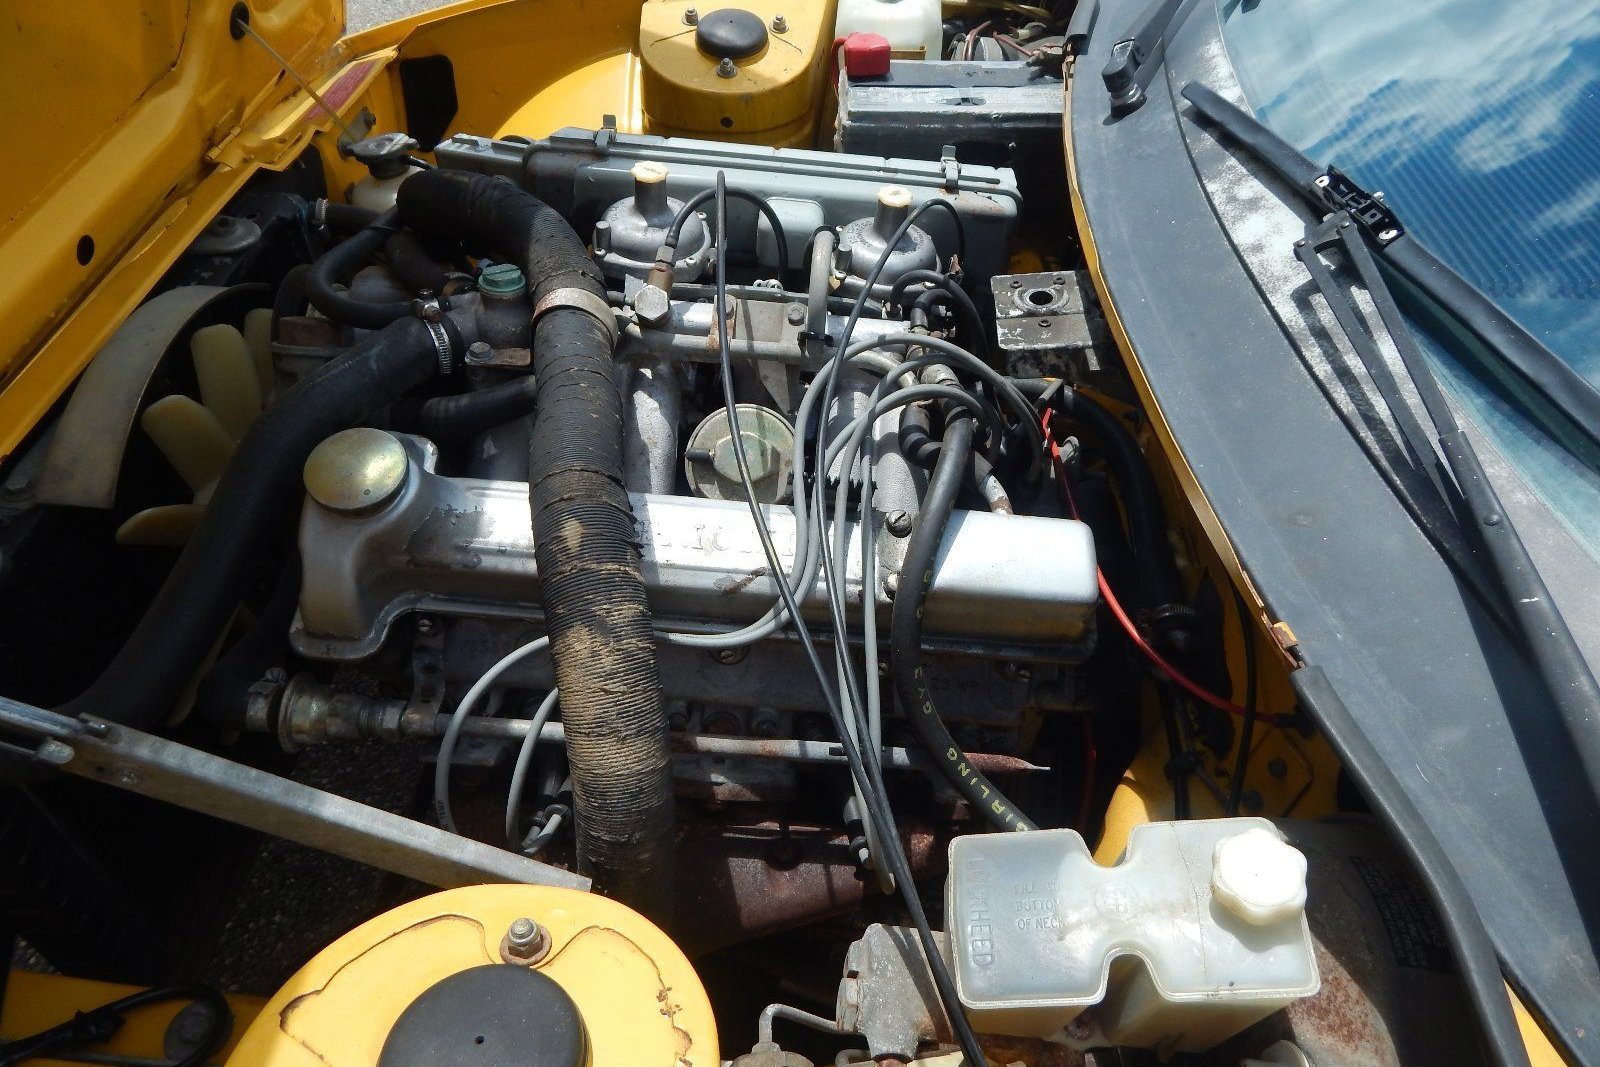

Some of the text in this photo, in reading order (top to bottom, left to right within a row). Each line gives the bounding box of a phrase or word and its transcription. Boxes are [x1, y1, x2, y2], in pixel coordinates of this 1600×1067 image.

[947, 747, 1029, 833] GIRLING
[1017, 917, 1064, 931] OF NECK
